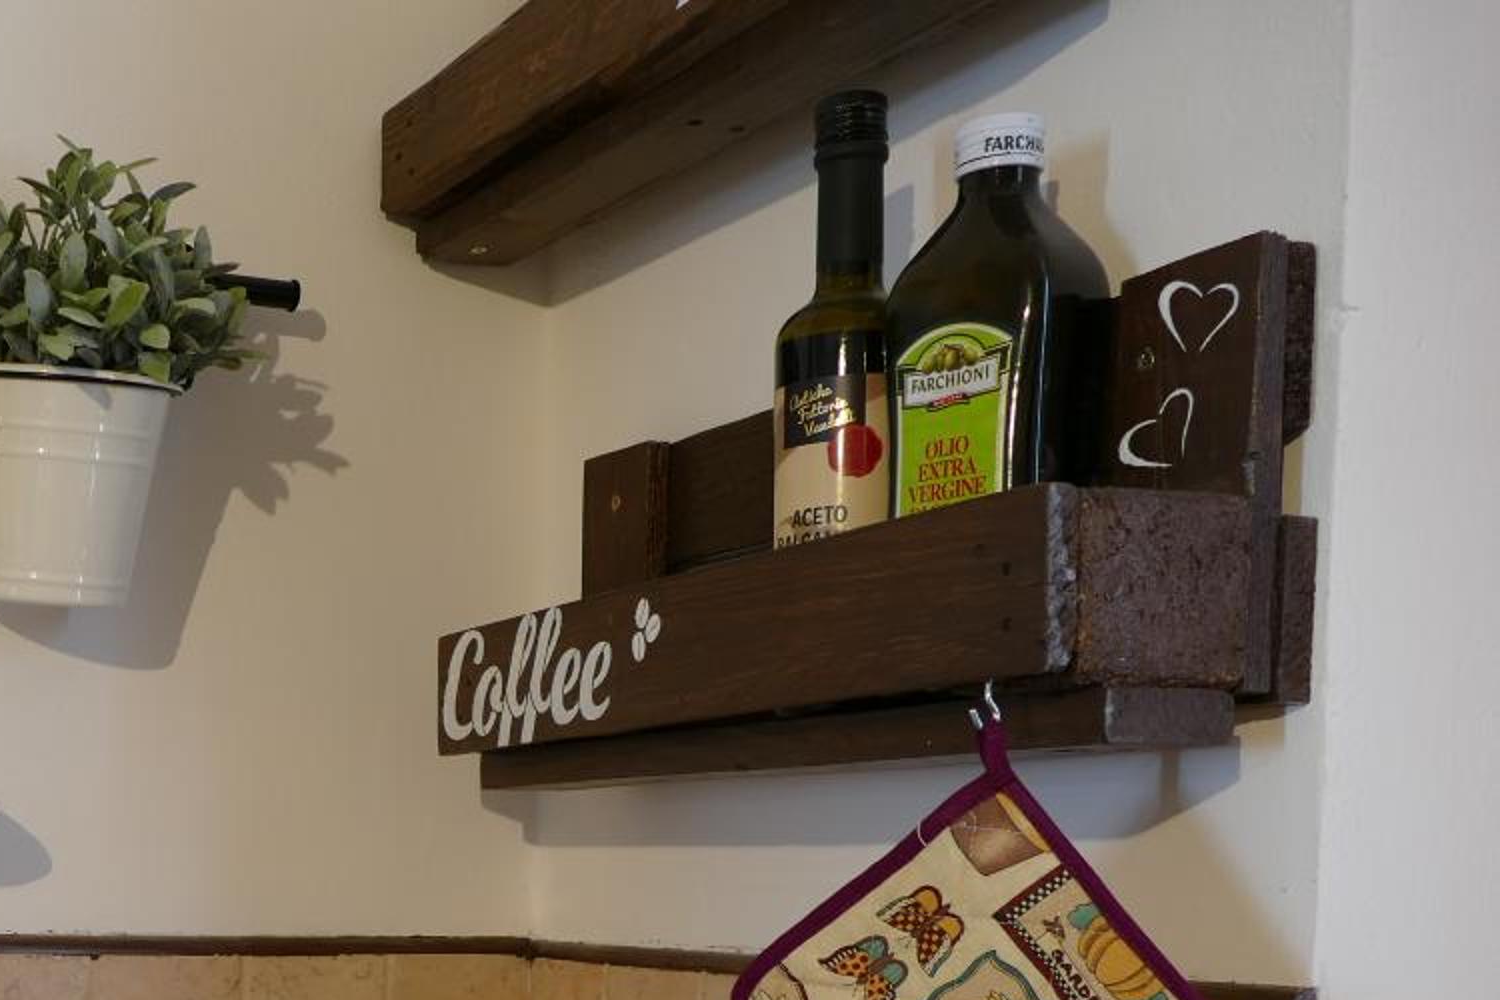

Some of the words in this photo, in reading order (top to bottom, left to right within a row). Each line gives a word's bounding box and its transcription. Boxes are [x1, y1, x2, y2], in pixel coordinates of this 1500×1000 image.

[911, 363, 989, 394] FARCHIONI
[925, 436, 969, 459] OLIO
[918, 456, 977, 482] EXTRA
[908, 475, 987, 502] VERGINE
[791, 505, 848, 528] ACETO
[443, 607, 612, 748] Coffee
